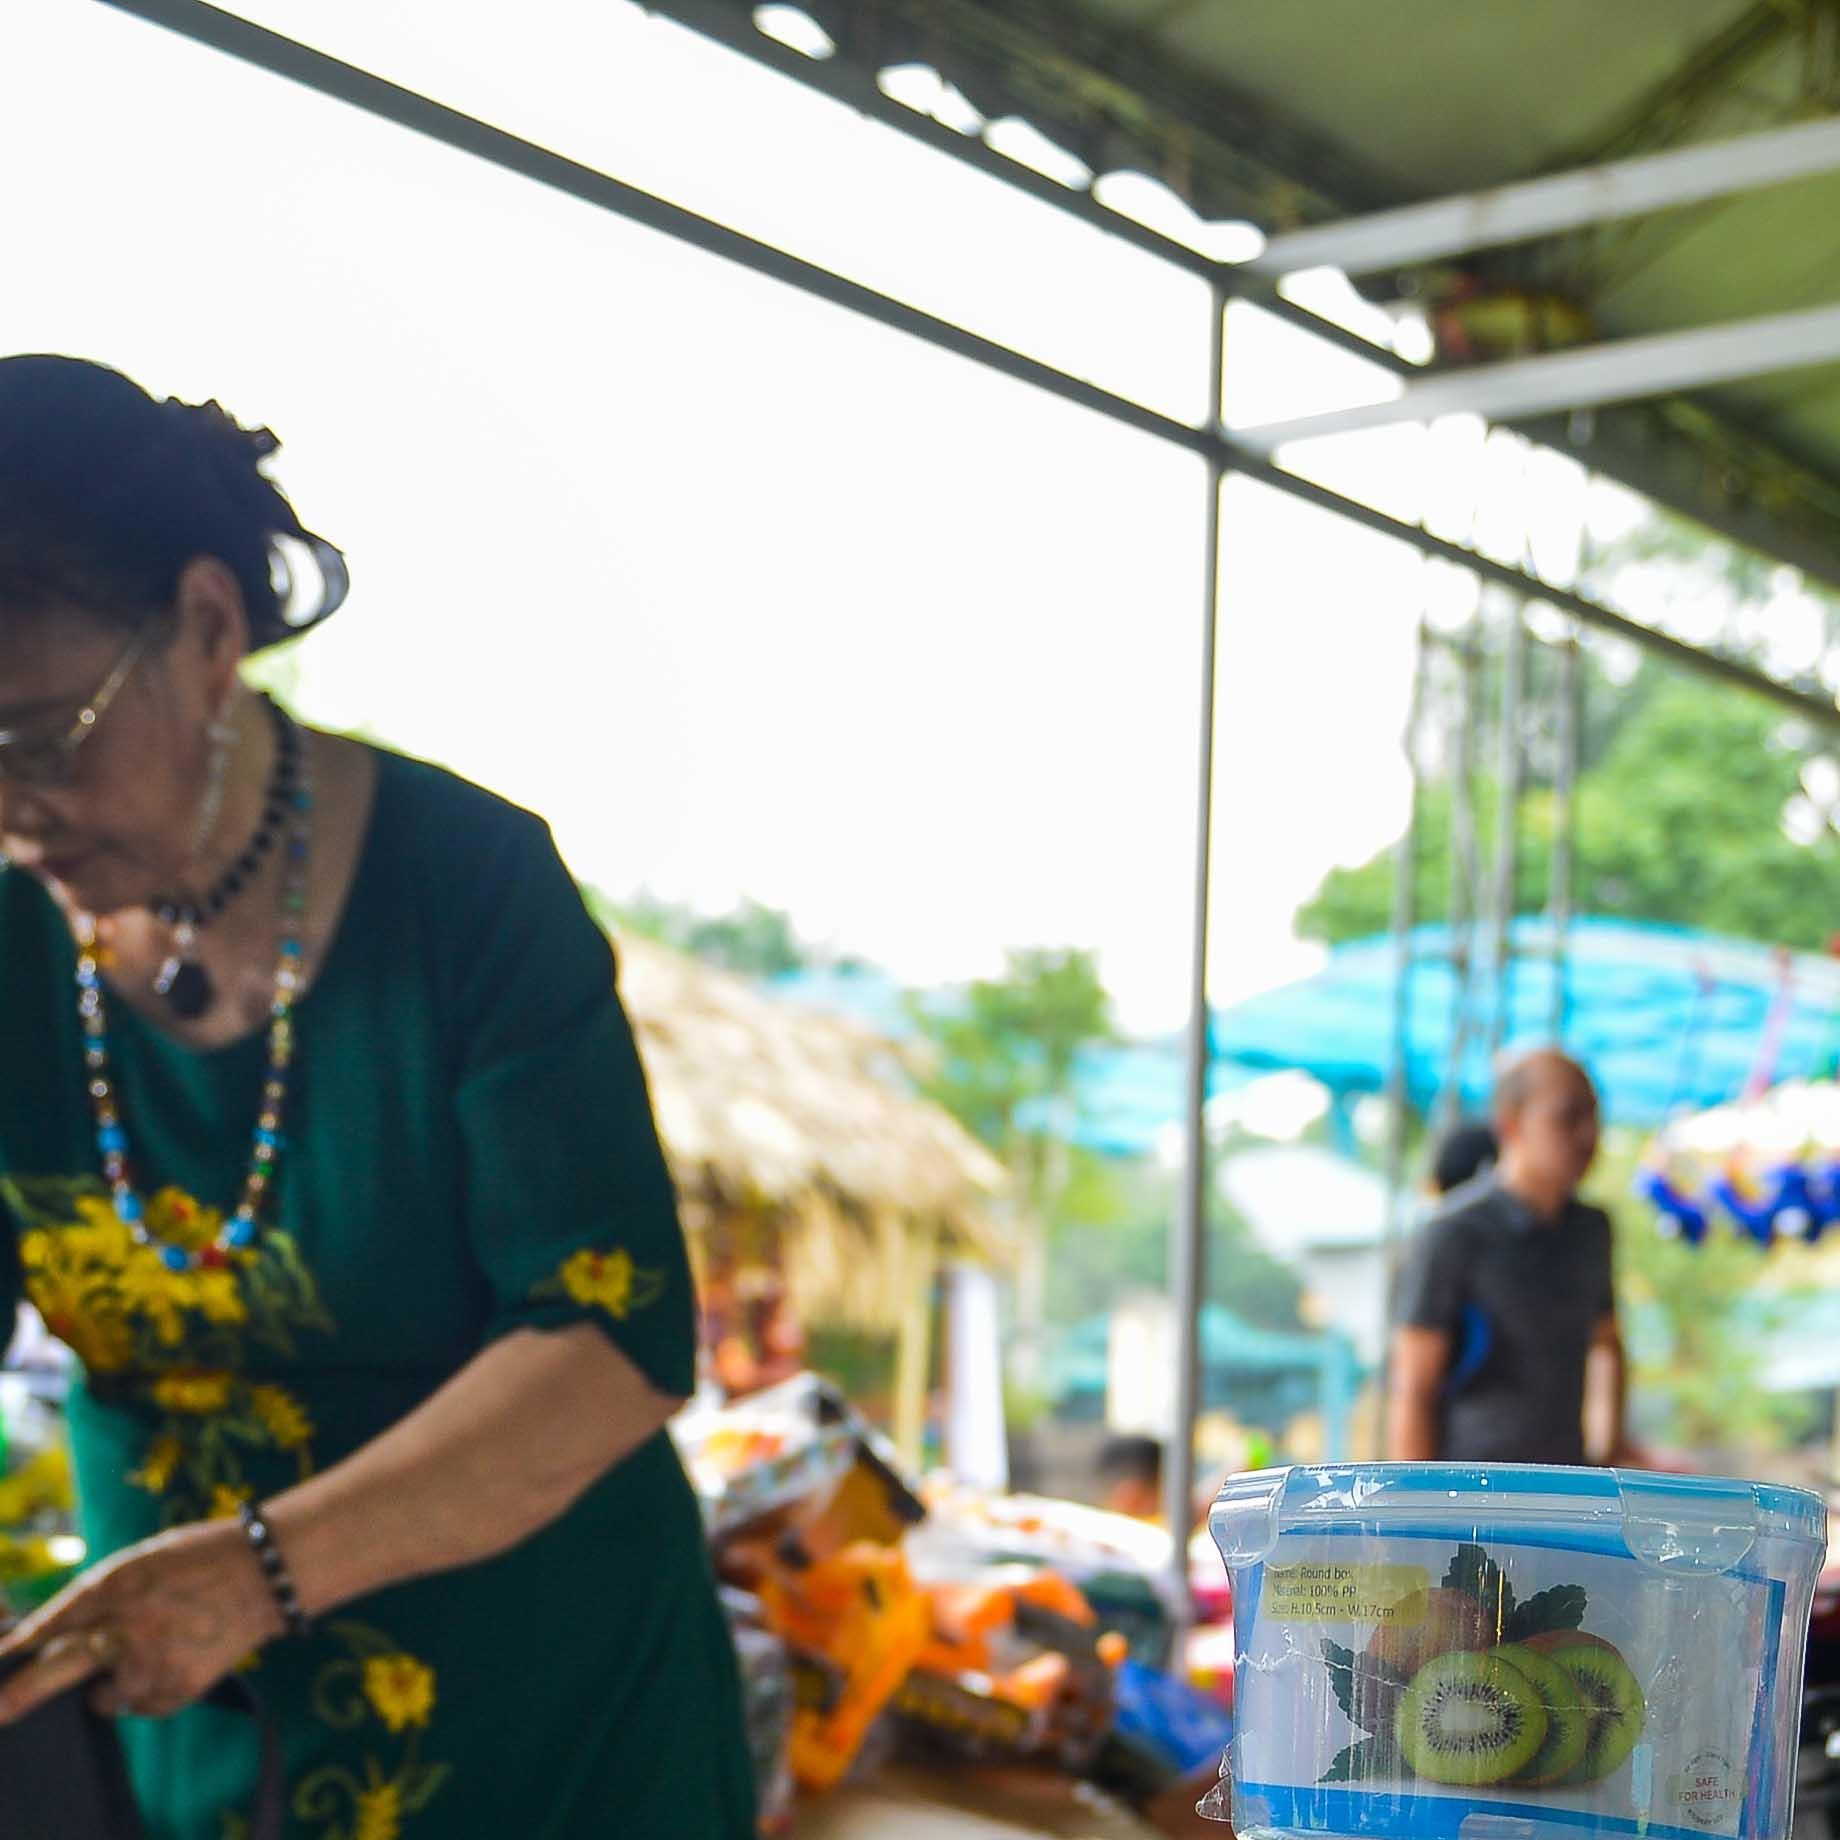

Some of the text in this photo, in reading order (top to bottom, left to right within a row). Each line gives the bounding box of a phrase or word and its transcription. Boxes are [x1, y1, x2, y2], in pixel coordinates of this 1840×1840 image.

[1300, 1567, 1331, 1580] Round
[1310, 1585, 1338, 1598] 100%
[1695, 1776, 1720, 1788] SAFE
[1679, 1789, 1737, 1801] FOR HEALTH
